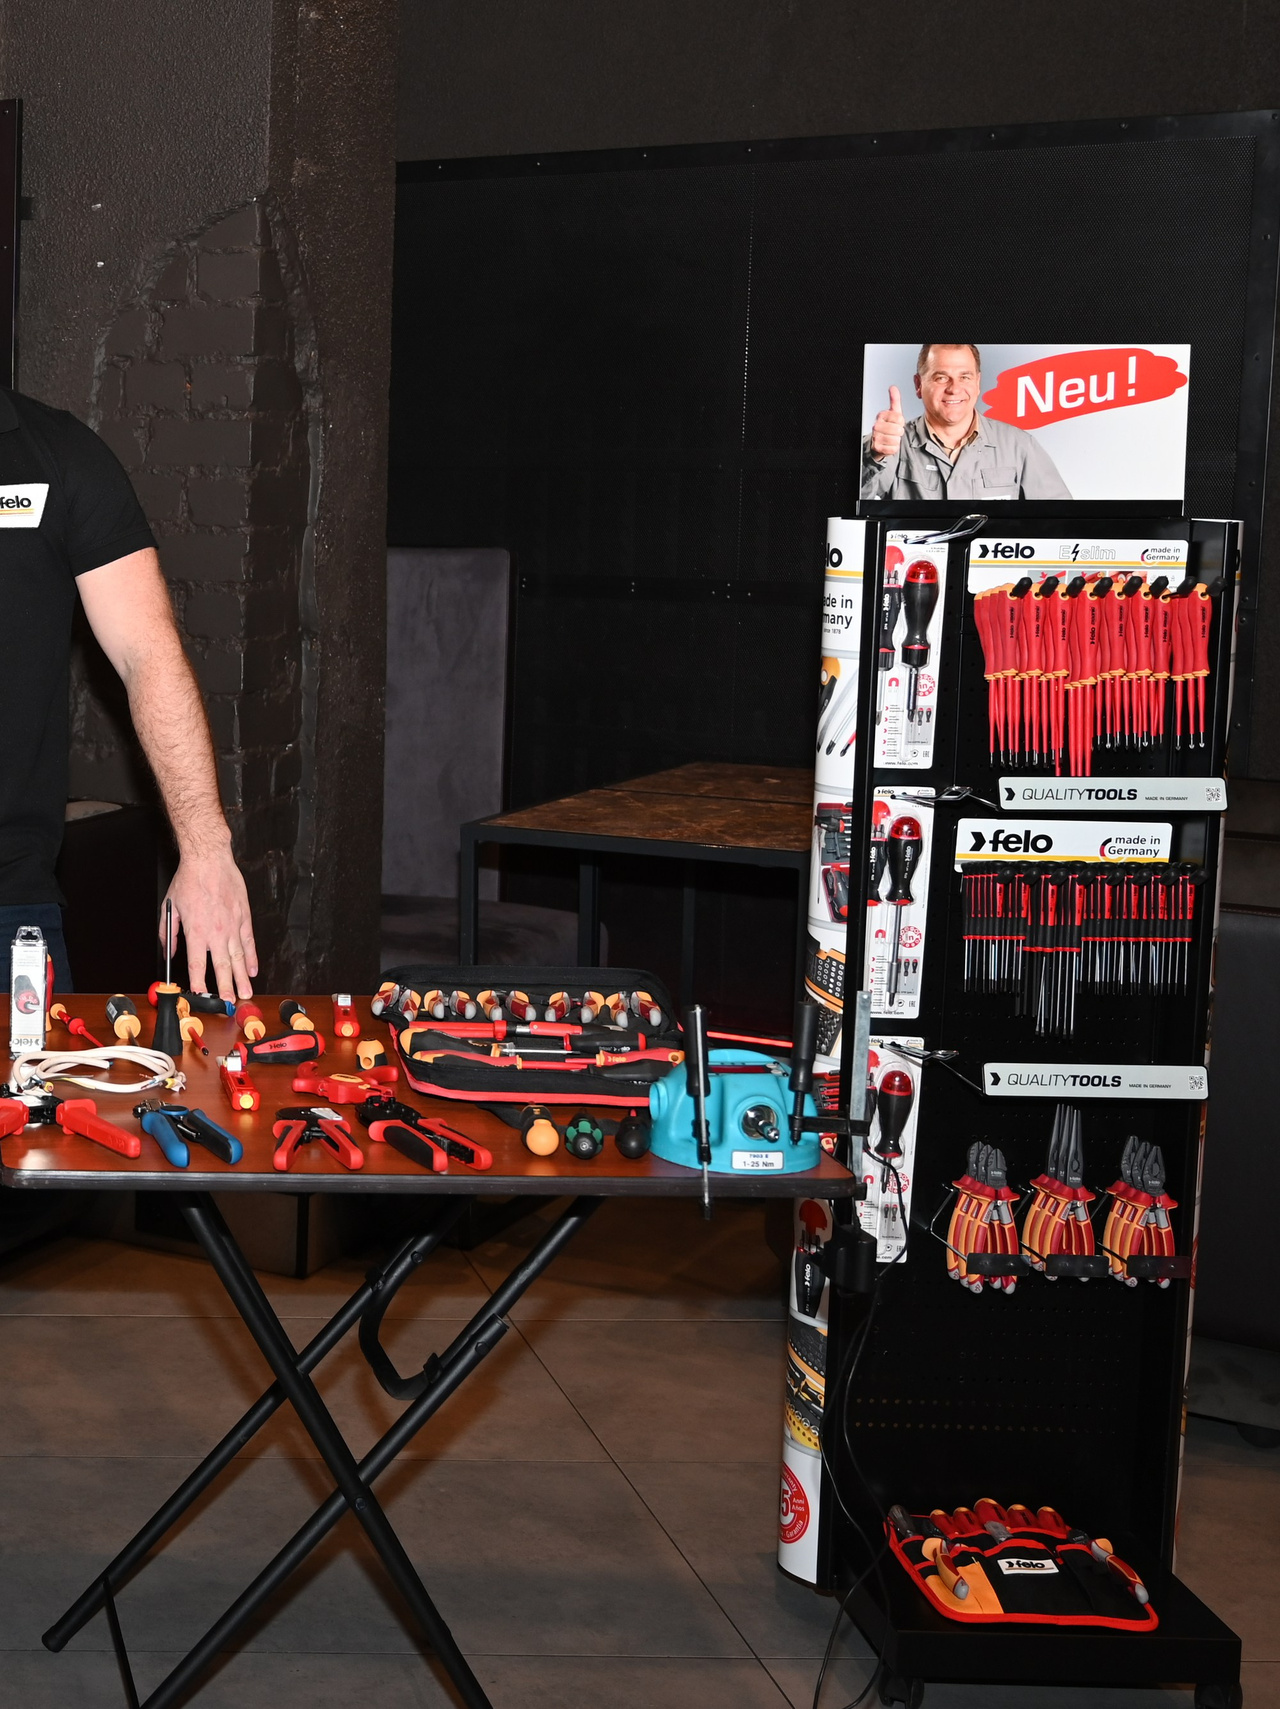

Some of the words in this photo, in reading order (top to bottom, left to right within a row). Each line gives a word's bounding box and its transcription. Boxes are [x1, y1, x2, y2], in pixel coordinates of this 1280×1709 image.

[1017, 371, 1115, 417] Neu
[992, 543, 1035, 559] felo
[1146, 554, 1181, 562] Germany
[841, 595, 853, 609] in
[989, 829, 1053, 853] felo
[1115, 835, 1147, 845] made
[1150, 835, 1160, 845] in
[1108, 846, 1160, 858] Germany
[804, 1264, 812, 1281] felo
[1016, 1560, 1046, 1568] felo
